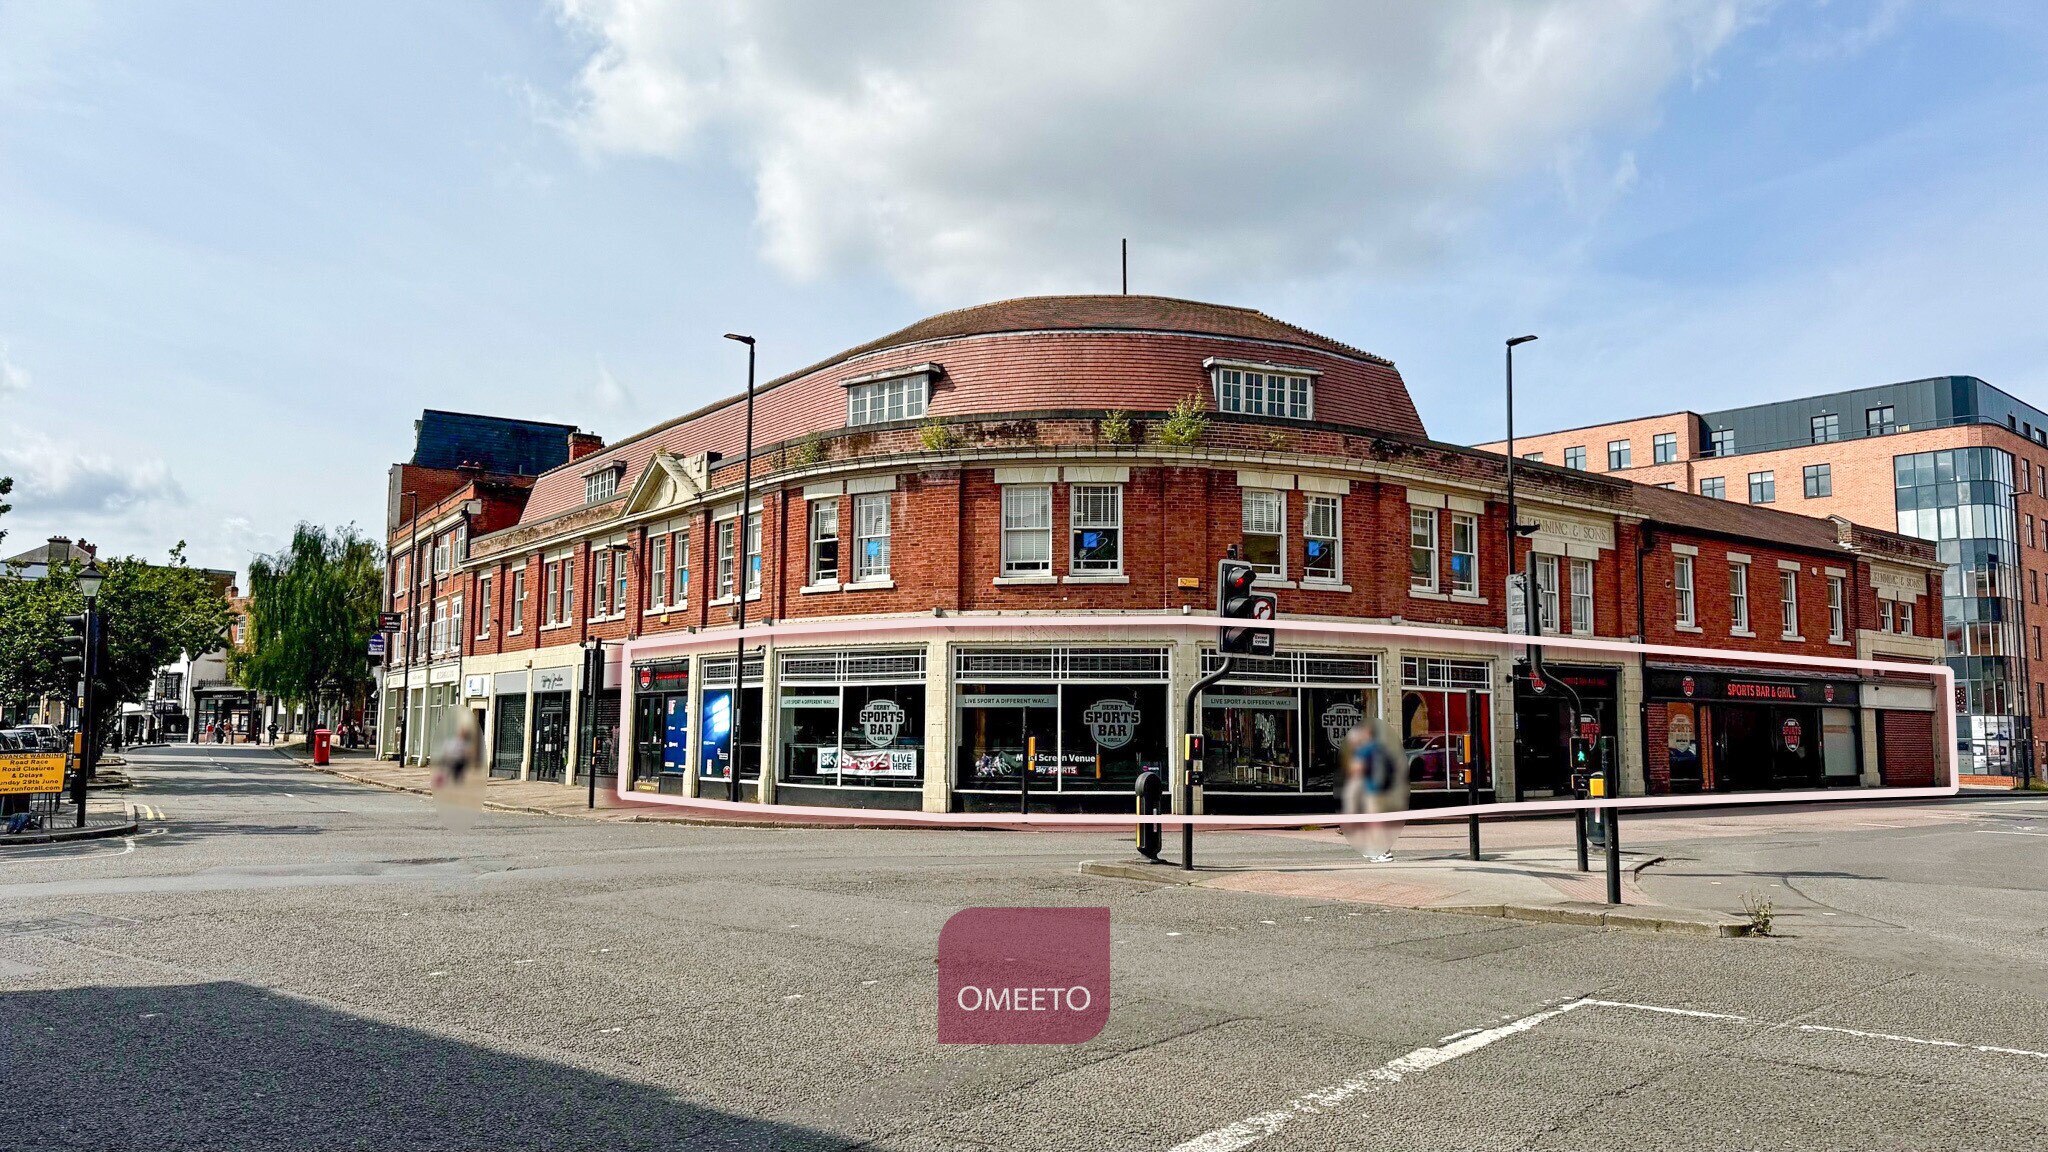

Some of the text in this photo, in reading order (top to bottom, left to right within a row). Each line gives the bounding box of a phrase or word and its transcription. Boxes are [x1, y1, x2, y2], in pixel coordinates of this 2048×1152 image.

[1727, 684, 1796, 698] SPORTS BAR & GRILL
[860, 711, 904, 723] SPORTS
[1085, 711, 1140, 724] SPORTS
[869, 723, 893, 735] BAR
[1097, 725, 1128, 737] BAR
[892, 753, 912, 763] LIVE
[1038, 753, 1068, 762] Scren
[1069, 754, 1096, 763] Venue
[892, 763, 912, 771] HERE
